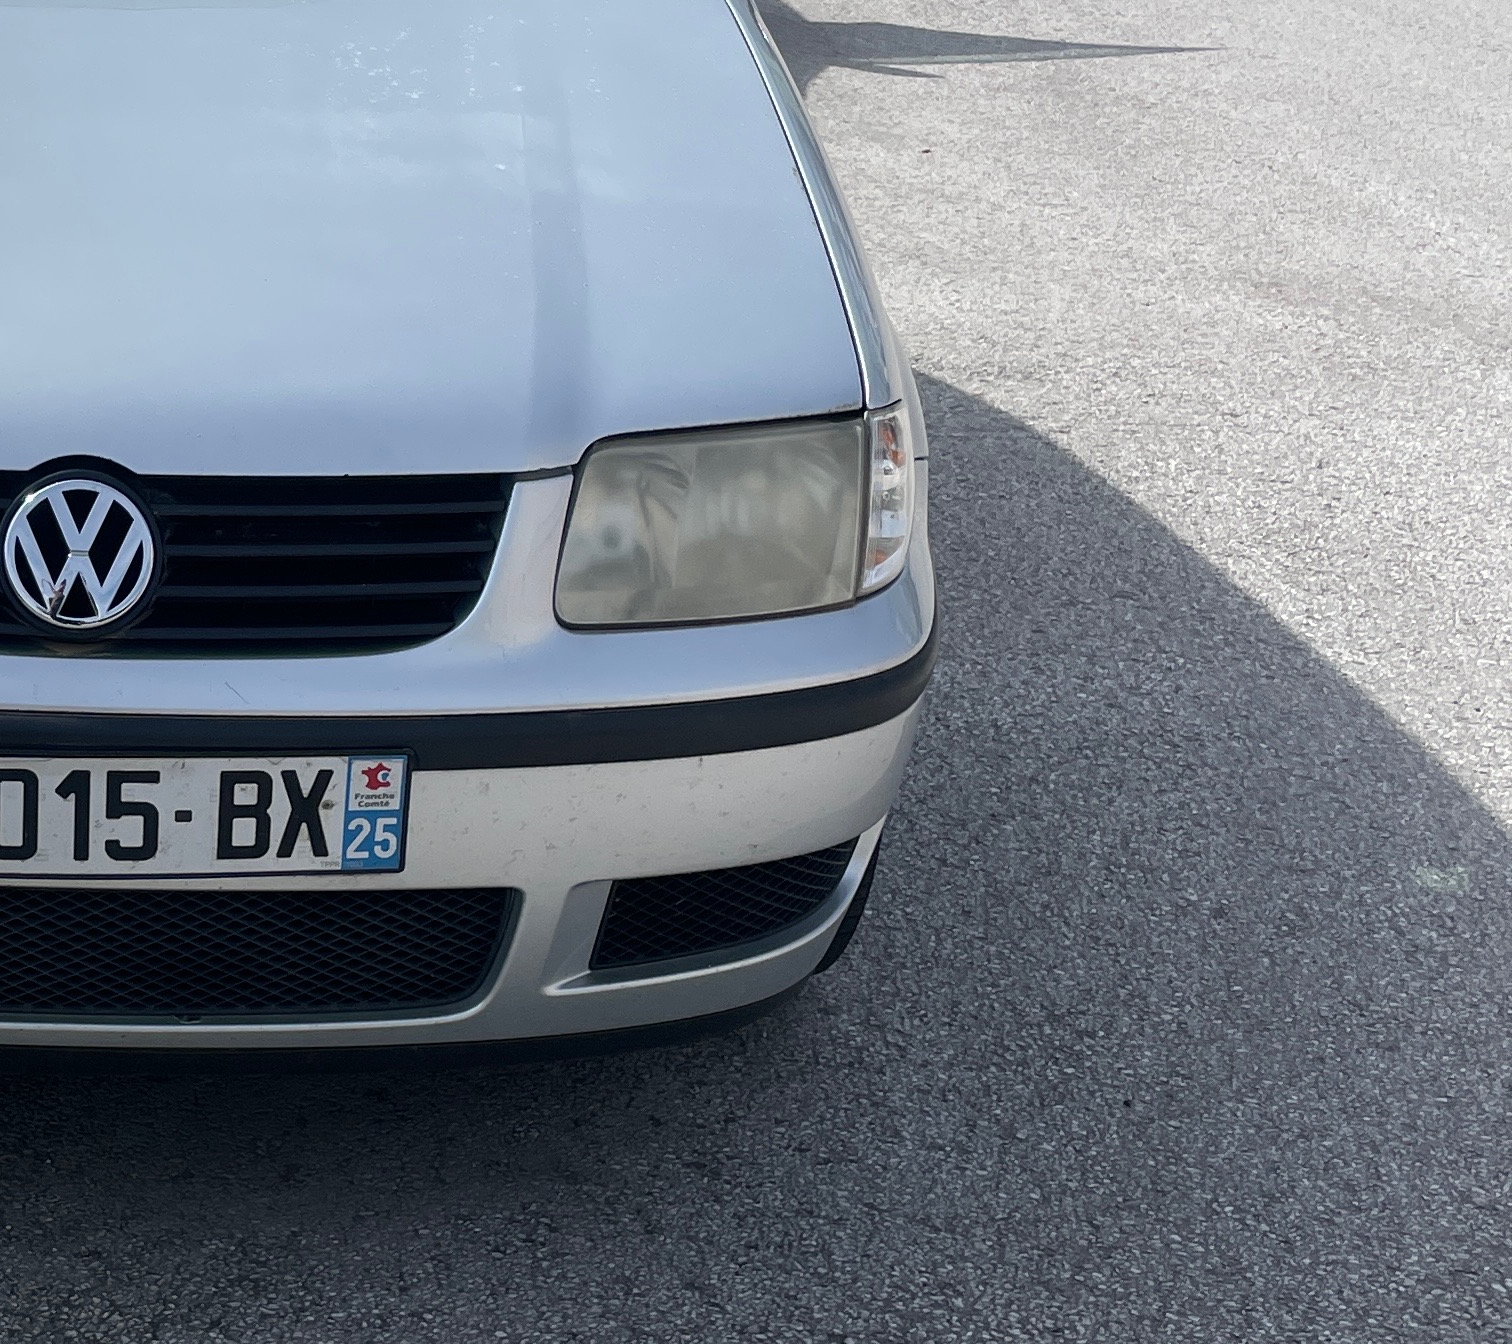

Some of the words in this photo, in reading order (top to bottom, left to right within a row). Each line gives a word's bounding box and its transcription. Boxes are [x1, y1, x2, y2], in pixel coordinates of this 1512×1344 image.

[354, 792, 395, 800] Franche
[357, 800, 390, 808] Comté
[345, 817, 397, 859] 25
